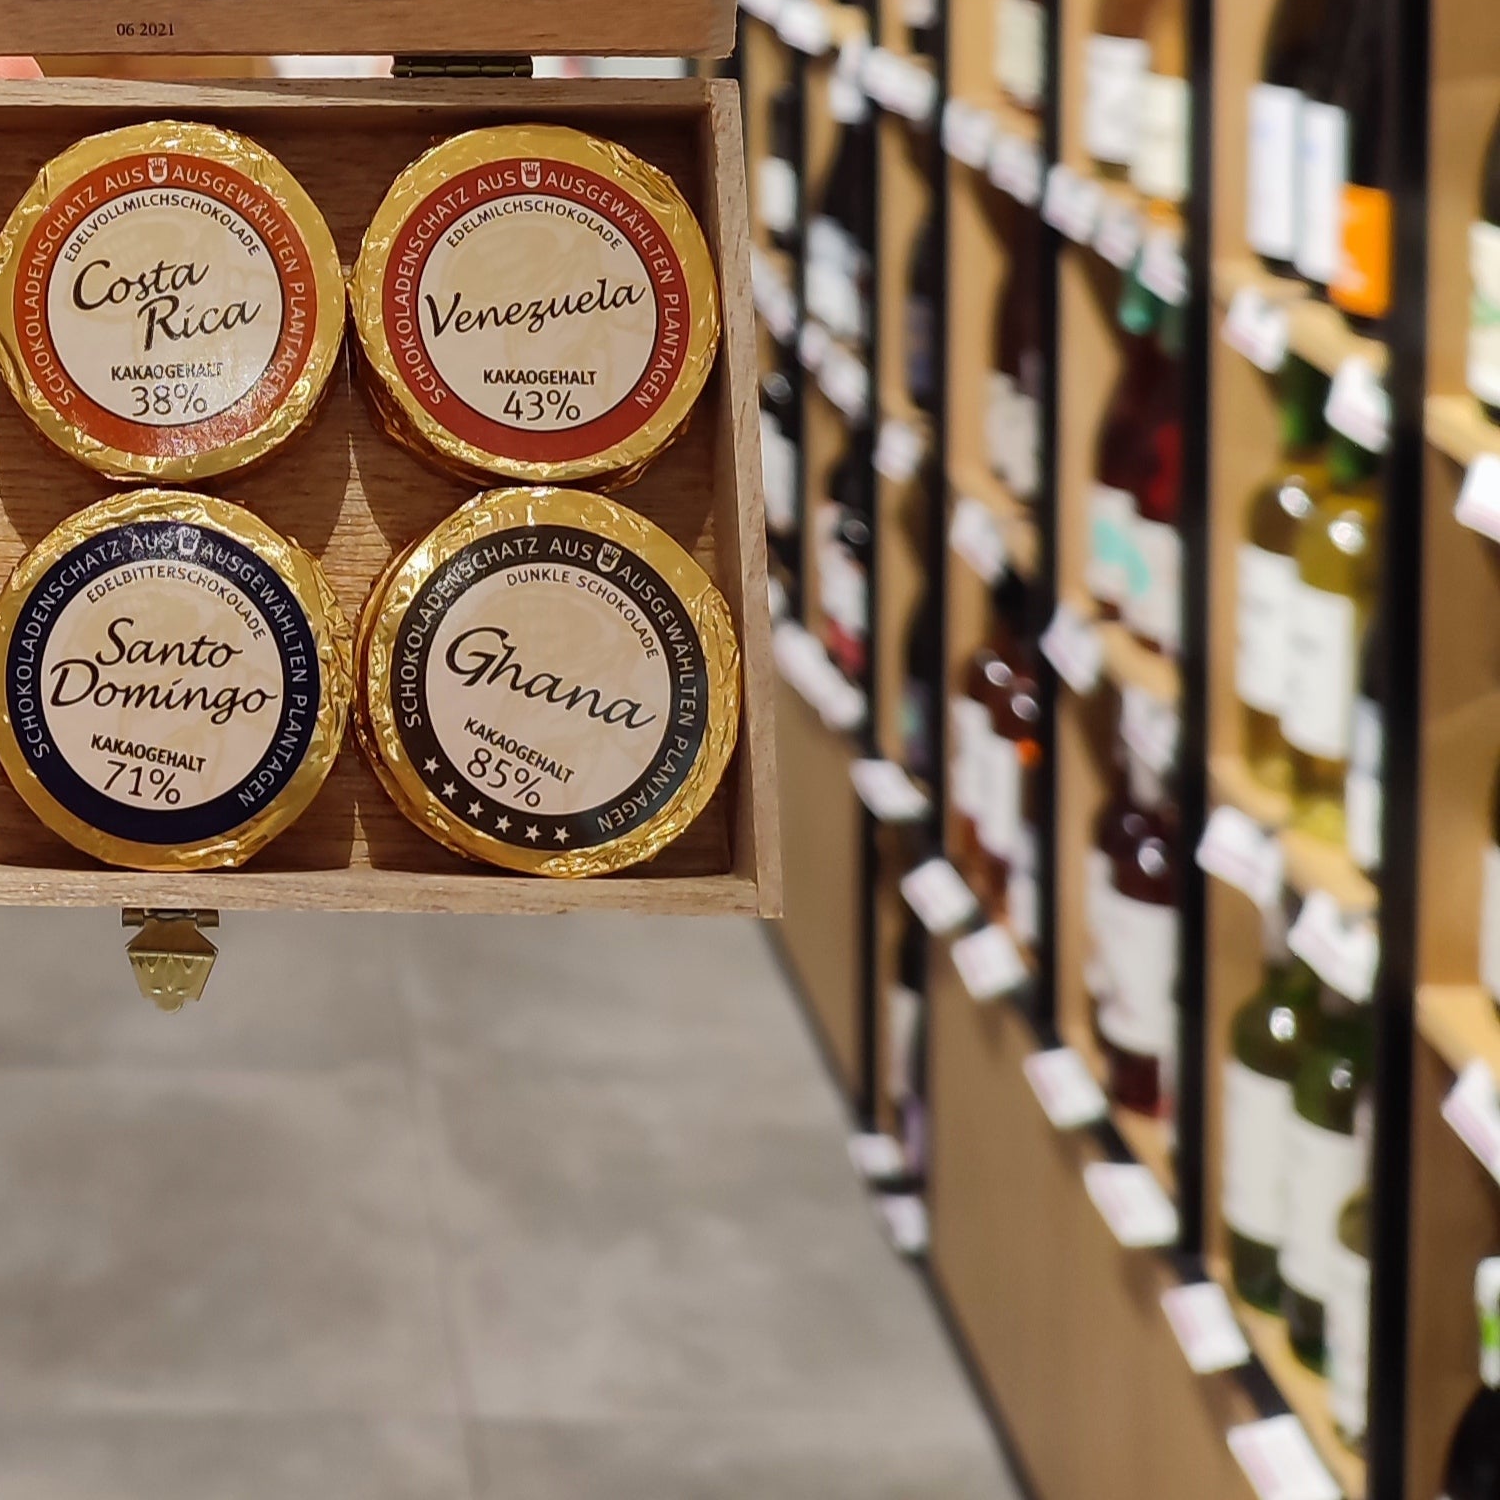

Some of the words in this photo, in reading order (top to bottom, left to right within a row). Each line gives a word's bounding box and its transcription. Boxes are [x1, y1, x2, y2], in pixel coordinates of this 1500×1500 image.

[116, 23, 135, 36] 06
[139, 23, 174, 36] 2021
[64, 193, 261, 264] EDELVOLLMILCHSCHOKOLADE
[447, 199, 623, 251] EDELMILCHSCHOKOLADE
[24, 186, 98, 406] SCHOKOLADENSCHATZ
[104, 167, 144, 193] AUS
[172, 165, 300, 273] AUSGEWÄHLTEN
[255, 281, 306, 403] PLANTAGEN
[72, 258, 209, 311] Costa
[394, 186, 471, 406] SCHOKOLADENSCHATZ
[476, 170, 517, 196] AUS
[544, 170, 675, 286] AUSGEWÄHLTEN
[634, 292, 681, 409] PLANTAGEN
[424, 277, 647, 339] Venezuela
[136, 293, 262, 351] Rica
[111, 362, 224, 381] KAKAOGEHALT
[131, 382, 208, 417] 38%
[483, 368, 598, 385] KAKAOGEHALT
[502, 390, 581, 422] 43%
[130, 532, 172, 553] AUS
[548, 536, 594, 561] AUS
[86, 564, 267, 641] EDELBITTERSCHOKOLADE
[199, 543, 309, 684] AUSGEWÄHLTEN
[399, 536, 541, 729] SCHOKOLADENSCHATZ
[506, 566, 571, 588] DUNKLE
[575, 574, 661, 661] SCHOKOLADE
[15, 540, 123, 760] SCHOKOLADENSCHATZ
[95, 616, 244, 669] Santo
[618, 564, 699, 728] AUSGEWÄHLTEN
[49, 658, 278, 726] Domingo
[444, 625, 658, 731] Ghana
[91, 732, 207, 774] KAKAOGEHALT
[238, 693, 309, 809] PLANTAGEN
[463, 715, 576, 785] KAKAOGEHALT
[464, 746, 542, 809] 85%
[103, 758, 182, 806] 71%
[596, 733, 689, 834] PLANTAGEN
